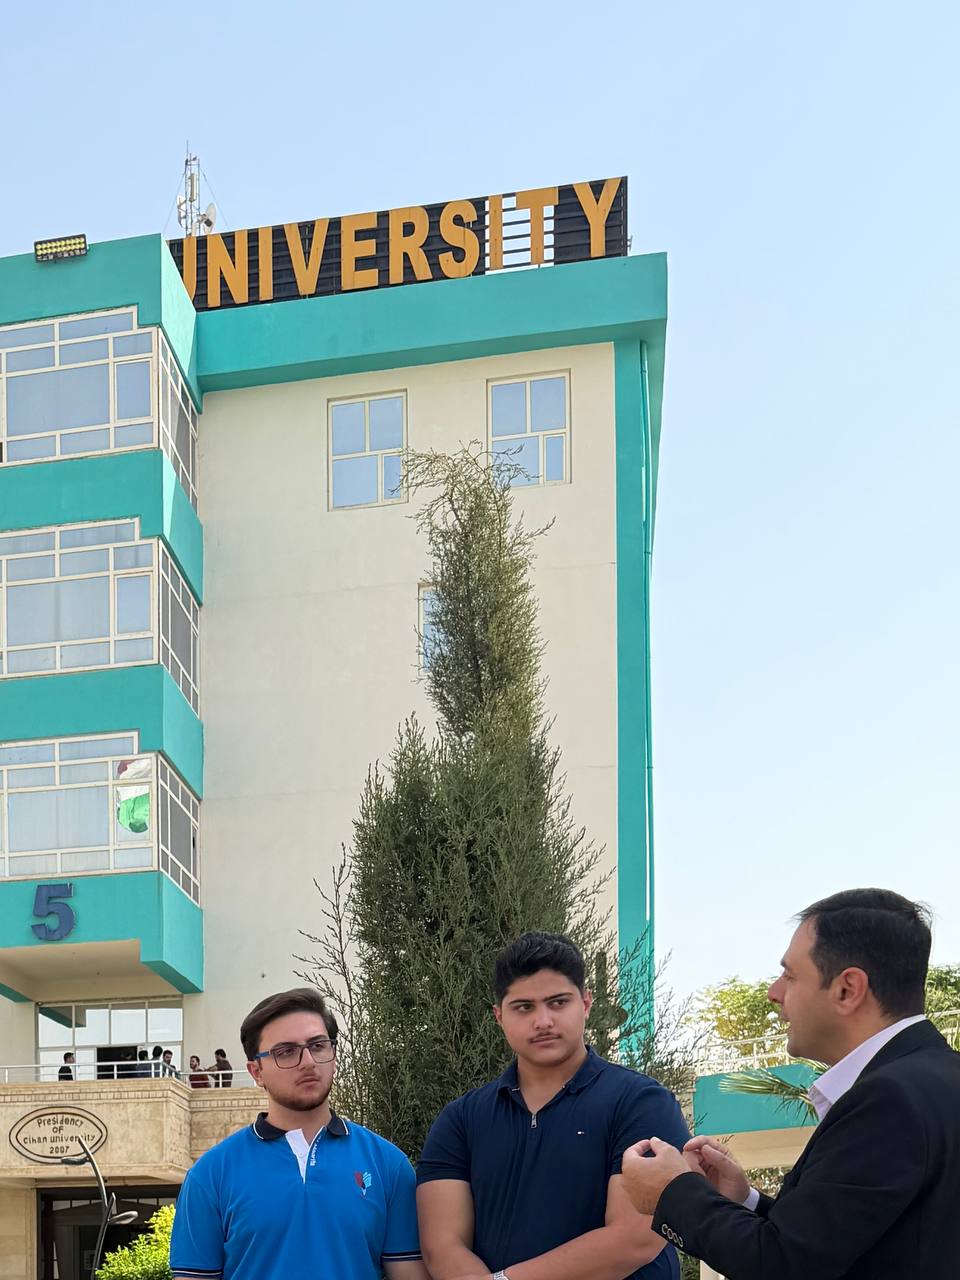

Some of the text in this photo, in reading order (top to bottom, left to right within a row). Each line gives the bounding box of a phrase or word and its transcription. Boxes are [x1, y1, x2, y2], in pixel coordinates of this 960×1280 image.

[31, 883, 75, 941] 5
[50, 1133, 95, 1143] univerity
[49, 1146, 70, 1154] 2007
